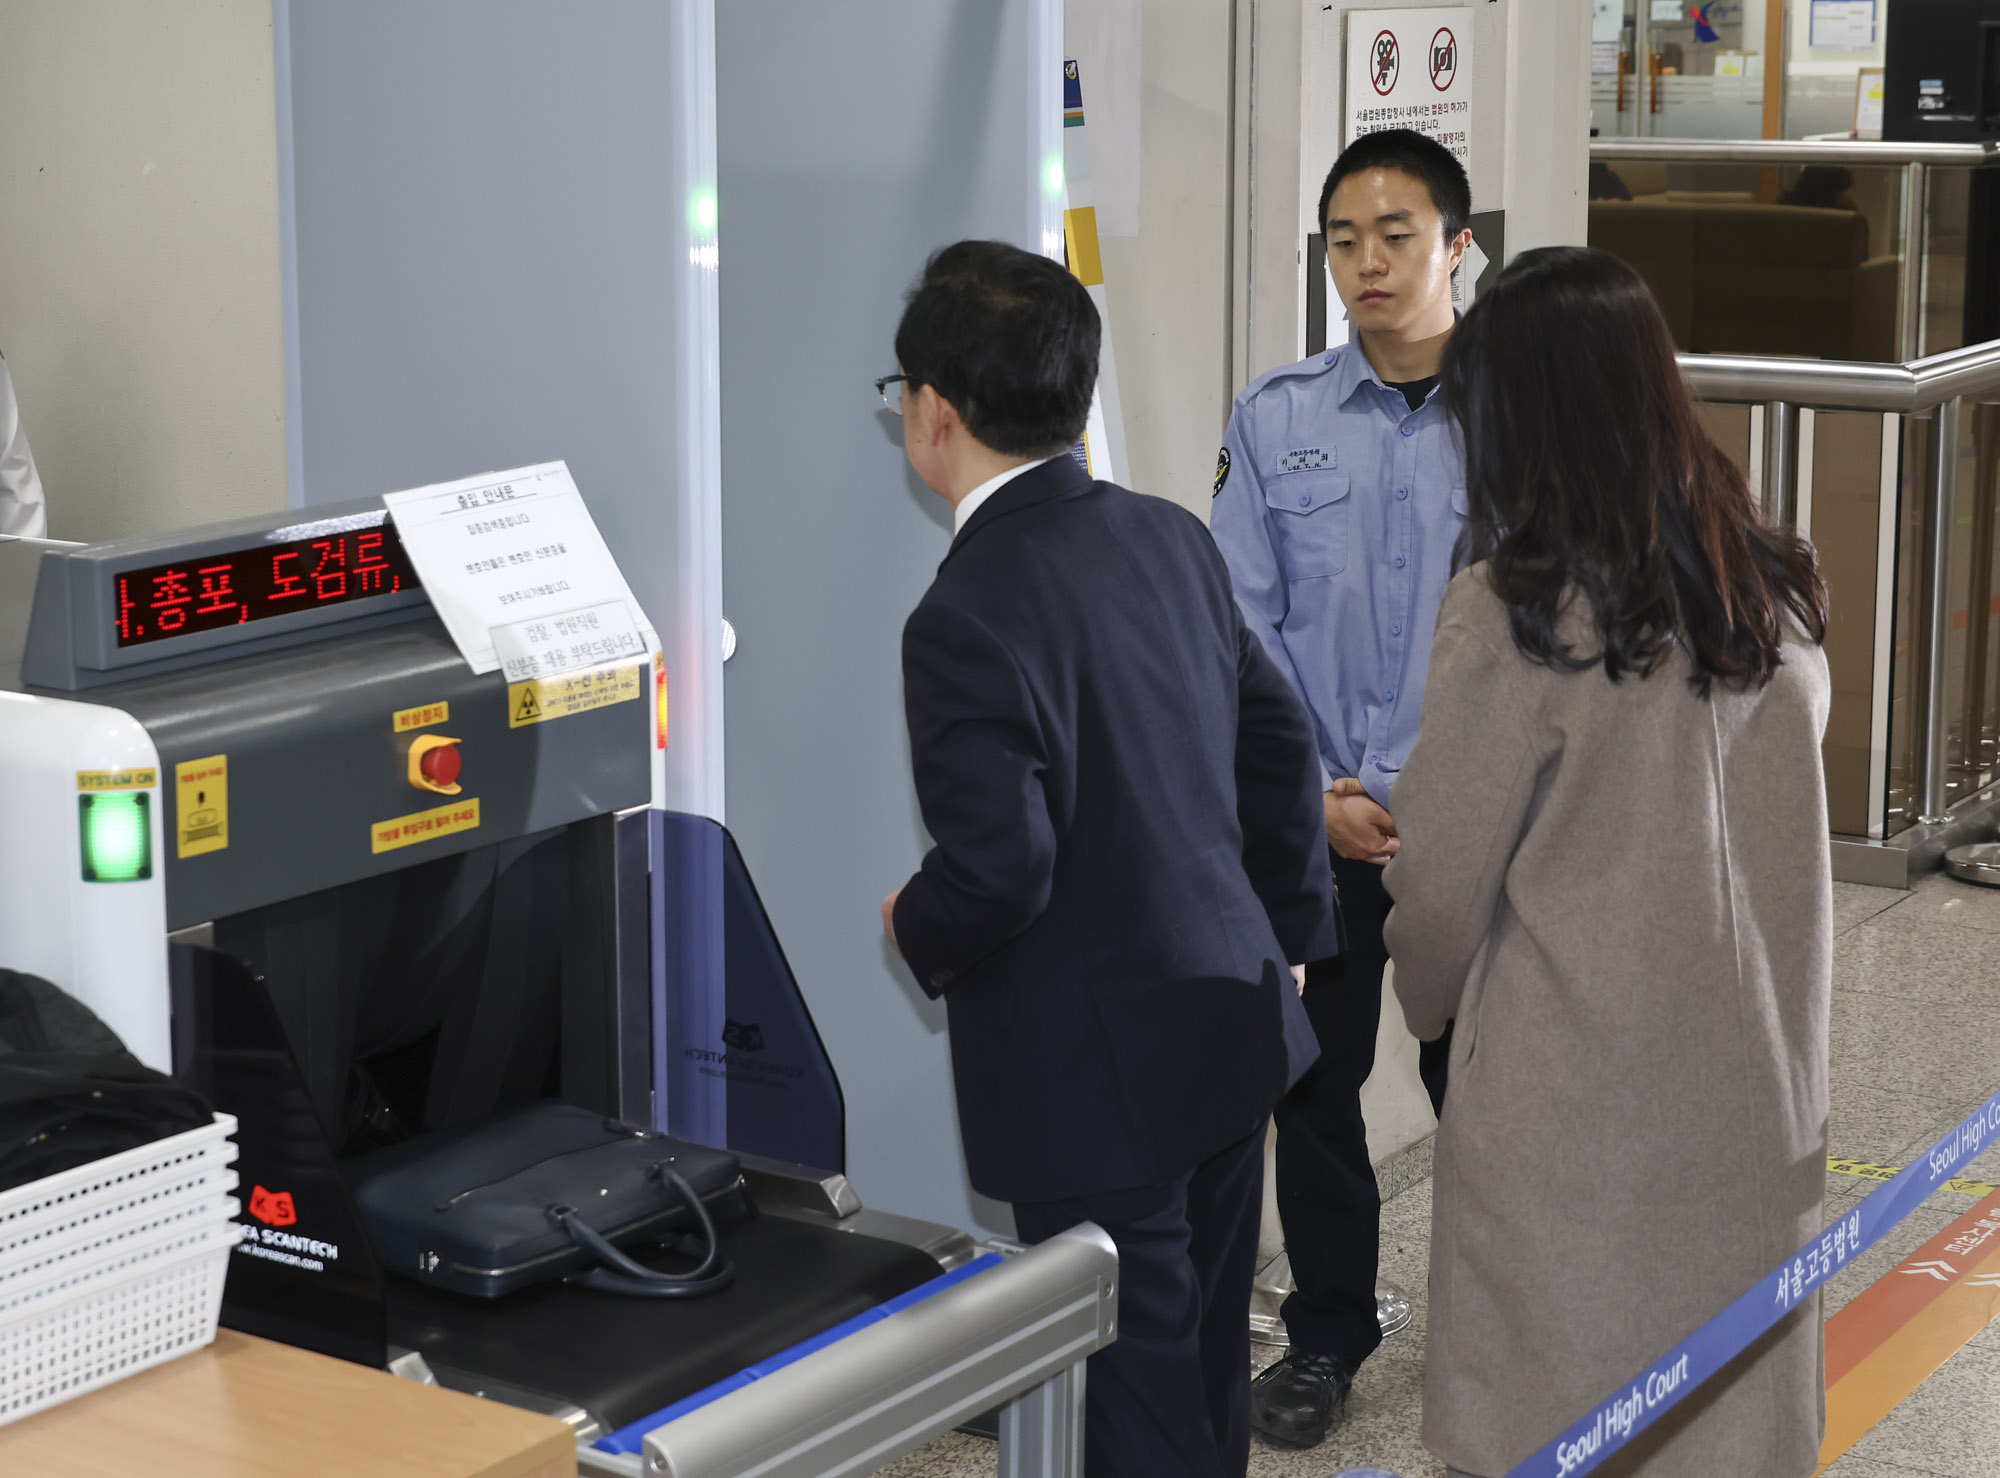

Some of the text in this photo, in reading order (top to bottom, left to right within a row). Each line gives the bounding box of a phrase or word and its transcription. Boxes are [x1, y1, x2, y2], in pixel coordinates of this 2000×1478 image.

[1357, 101, 1467, 121] 서울법원종합청사 내에서는 법원의 허가가
[1415, 118, 1441, 132] 있습니다.
[457, 484, 515, 509] 출입 안내문
[267, 531, 400, 600] 도검류,
[524, 610, 601, 643] 검찰, 법원직원
[506, 655, 541, 678] 신분증
[570, 632, 640, 662] 부탁드립니다.
[79, 772, 154, 787] SYSTEM ON
[1929, 1130, 1959, 1180] Seoul
[1961, 1101, 1986, 1154] High
[260, 1228, 339, 1260] SCANTECH
[1774, 1209, 1860, 1308] 서울고등법원
[1555, 1352, 1689, 1478] Seoul High Court
